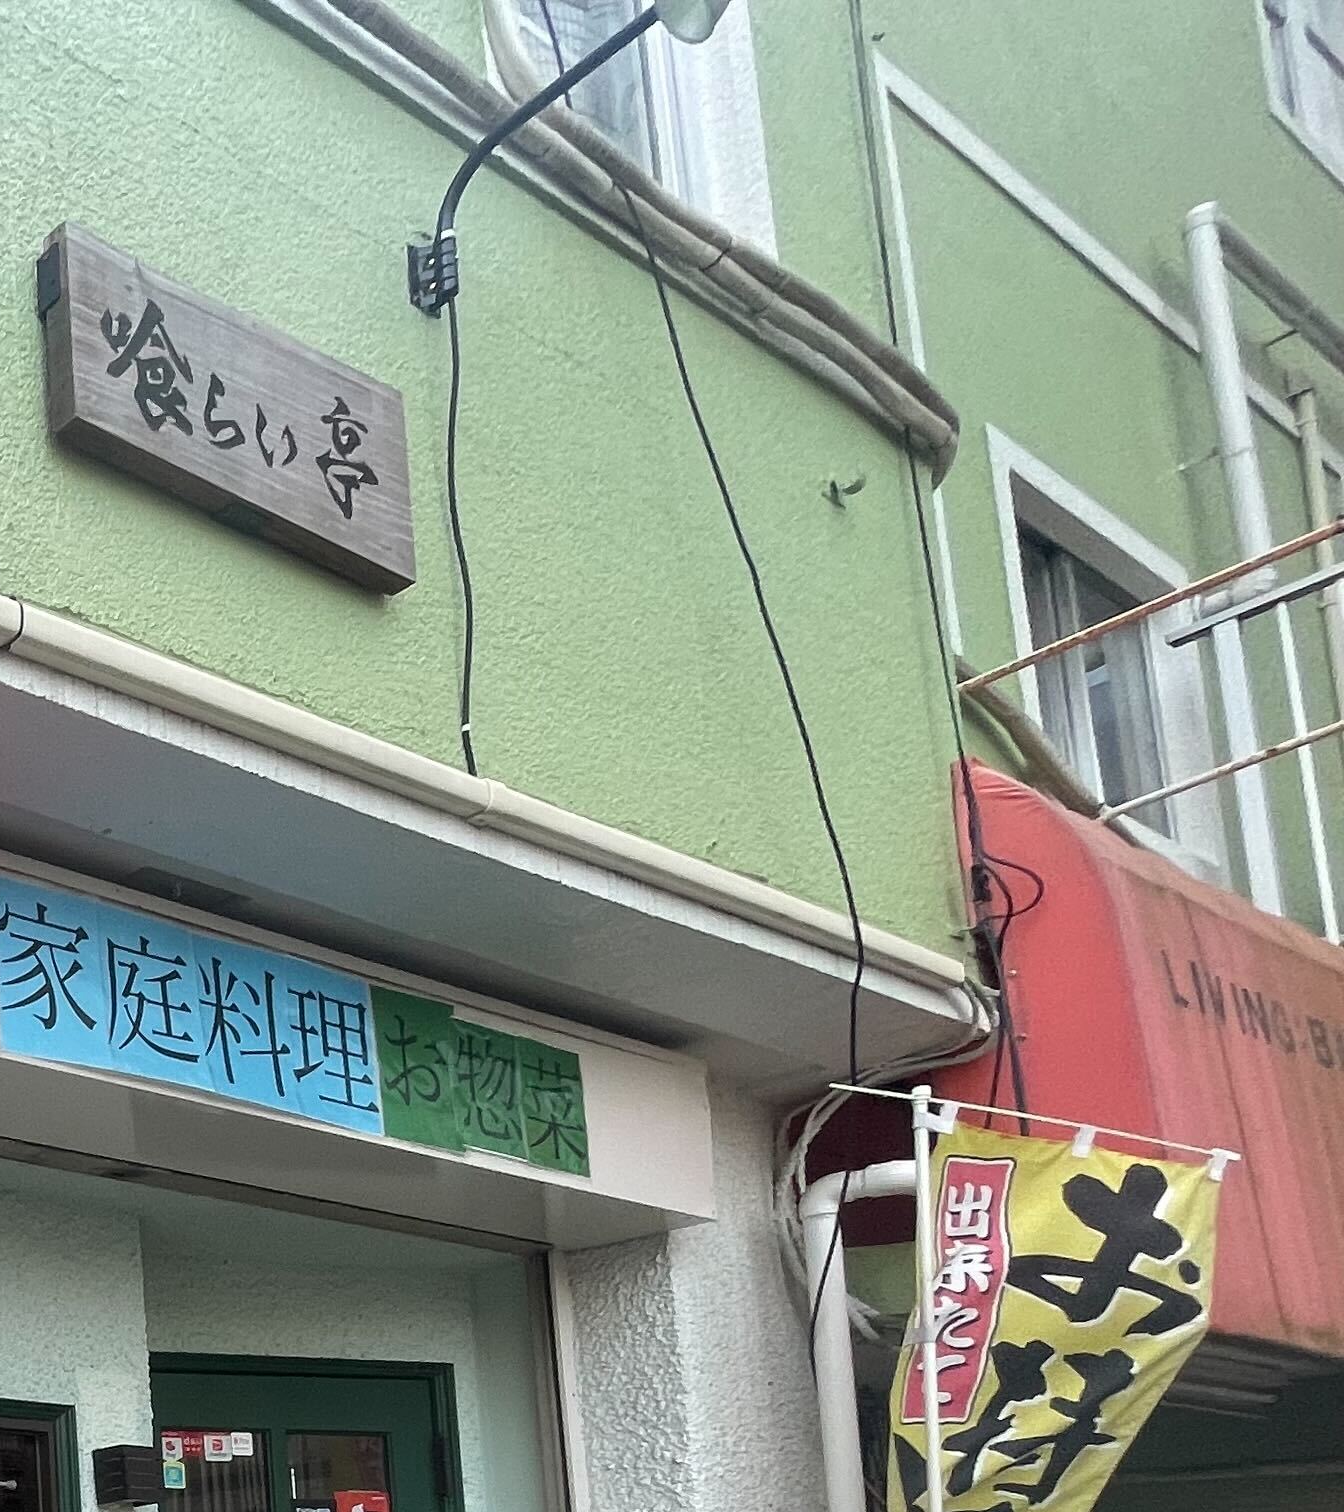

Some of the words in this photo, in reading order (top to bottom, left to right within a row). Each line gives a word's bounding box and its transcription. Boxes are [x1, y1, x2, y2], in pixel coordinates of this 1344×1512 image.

[100, 298, 379, 520] 喰らい亭
[384, 1013, 588, 1170] お惣菜
